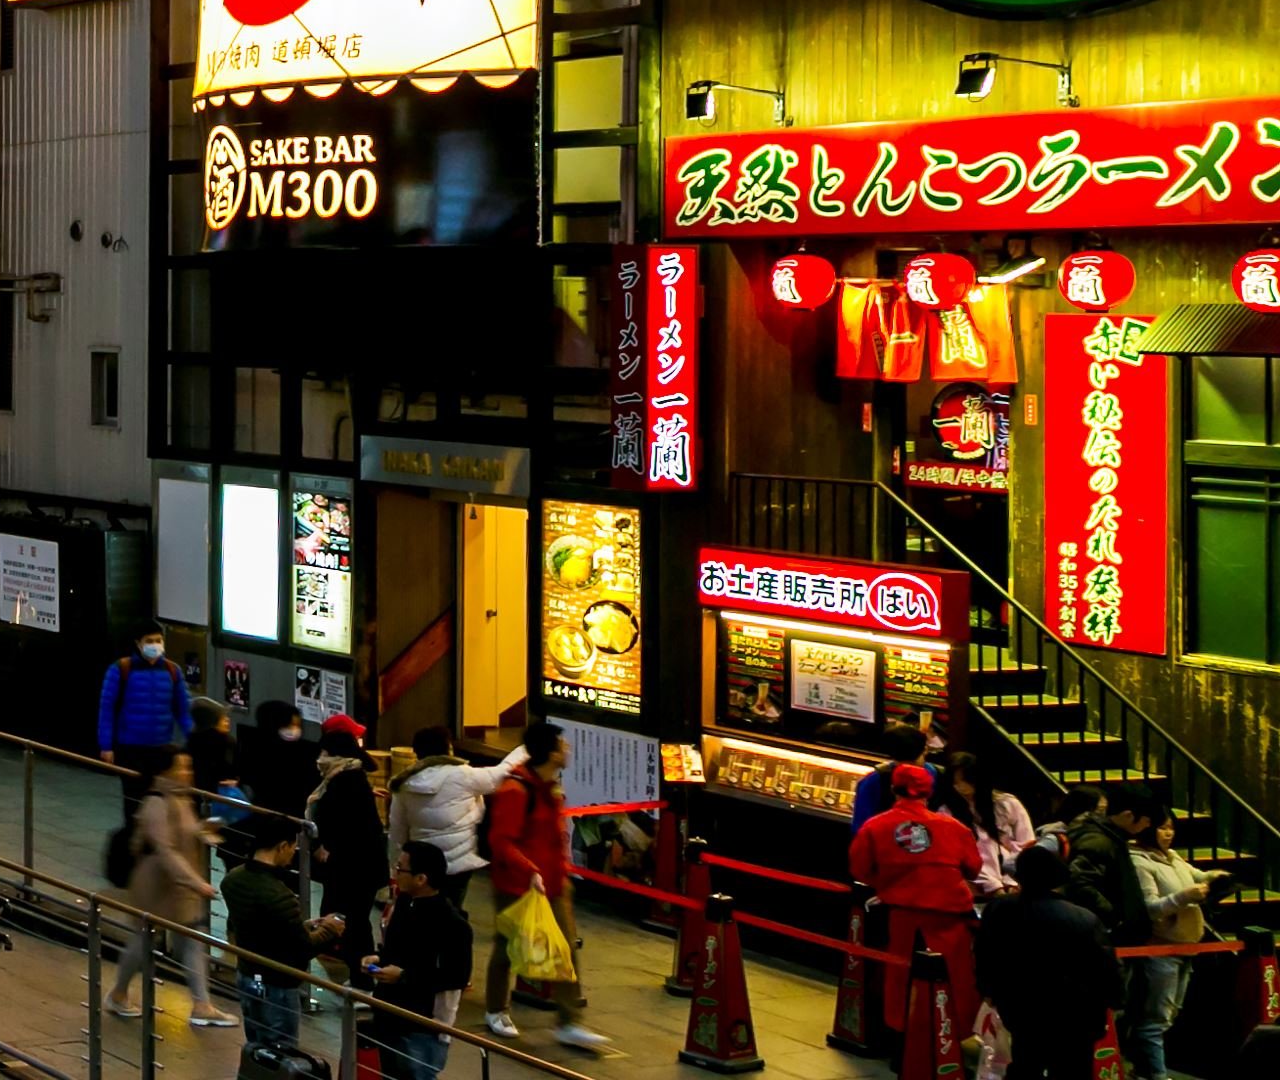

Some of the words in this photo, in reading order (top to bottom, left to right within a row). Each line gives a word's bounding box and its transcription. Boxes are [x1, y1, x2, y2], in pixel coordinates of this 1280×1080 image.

[250, 136, 309, 167] SAKE
[314, 134, 376, 164] BAR
[247, 168, 378, 219] M300
[1068, 255, 1105, 305] 一蘭
[656, 252, 690, 386] ラーメン
[649, 392, 691, 487] 一蘭
[700, 560, 867, 616] お土産販売所
[875, 584, 930, 619] はい
[1058, 541, 1078, 639] 昭和35年創業
